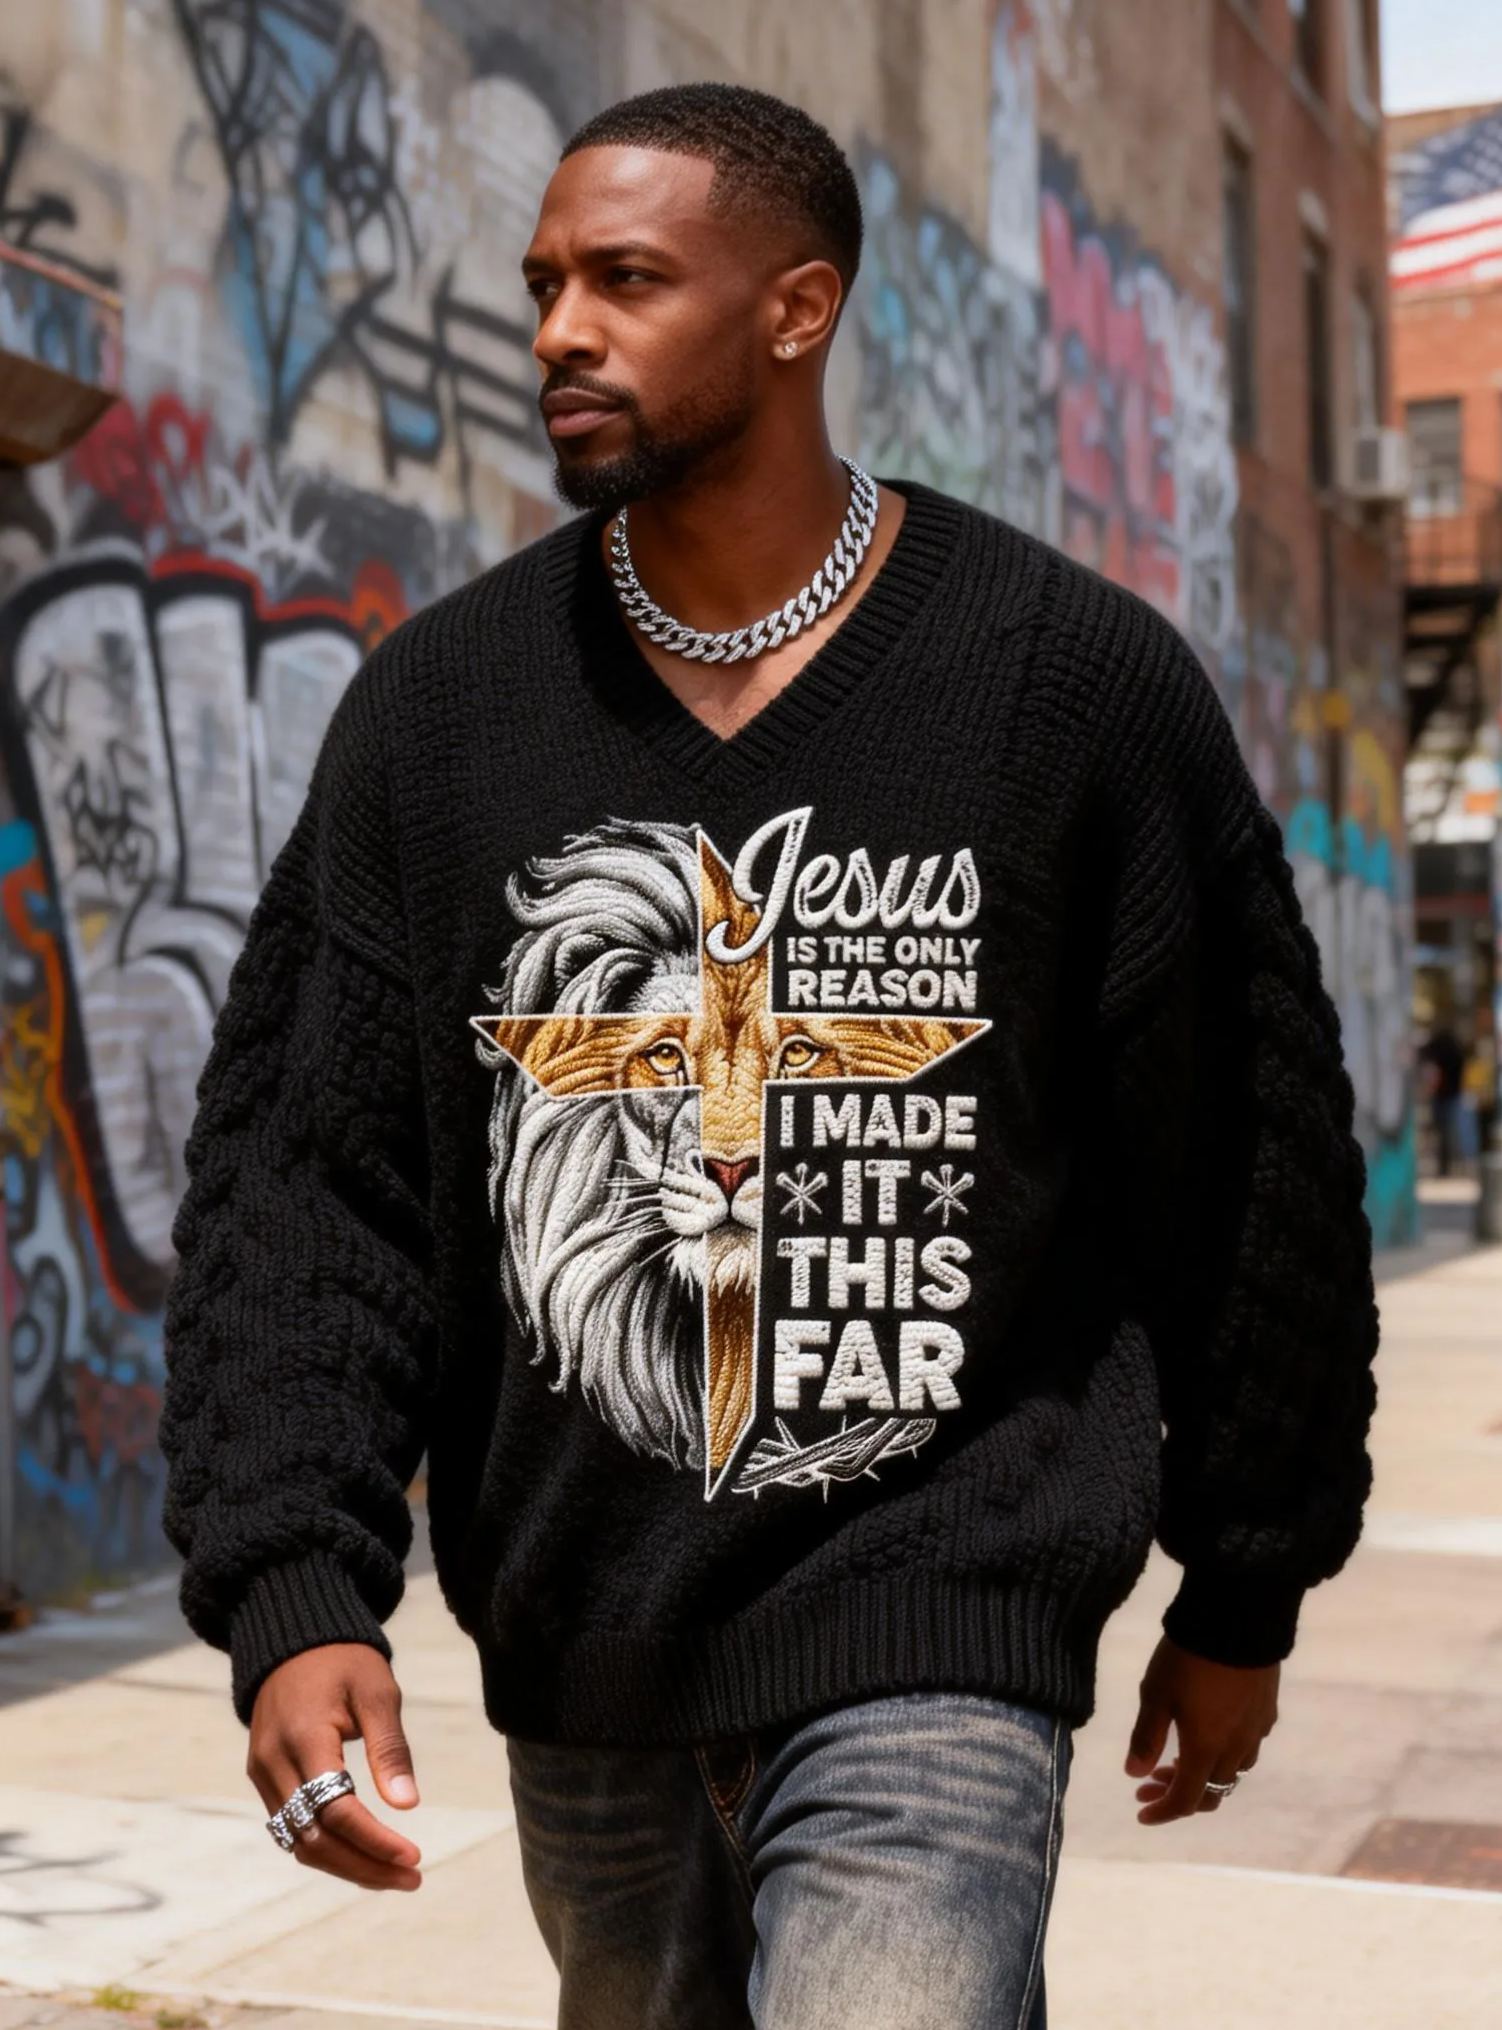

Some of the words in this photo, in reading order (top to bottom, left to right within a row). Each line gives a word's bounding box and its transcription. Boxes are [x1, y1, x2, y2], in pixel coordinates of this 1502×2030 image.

[706, 806, 981, 963] Jesus
[787, 937, 817, 964] IS
[823, 936, 886, 963] THE
[895, 936, 981, 966] ONLY
[787, 969, 977, 1010] REASON
[780, 1095, 795, 1147] I
[813, 1094, 977, 1149] MADE
[842, 1159, 911, 1225] IT
[777, 1236, 972, 1310] THIS
[773, 1319, 965, 1410] FAR
